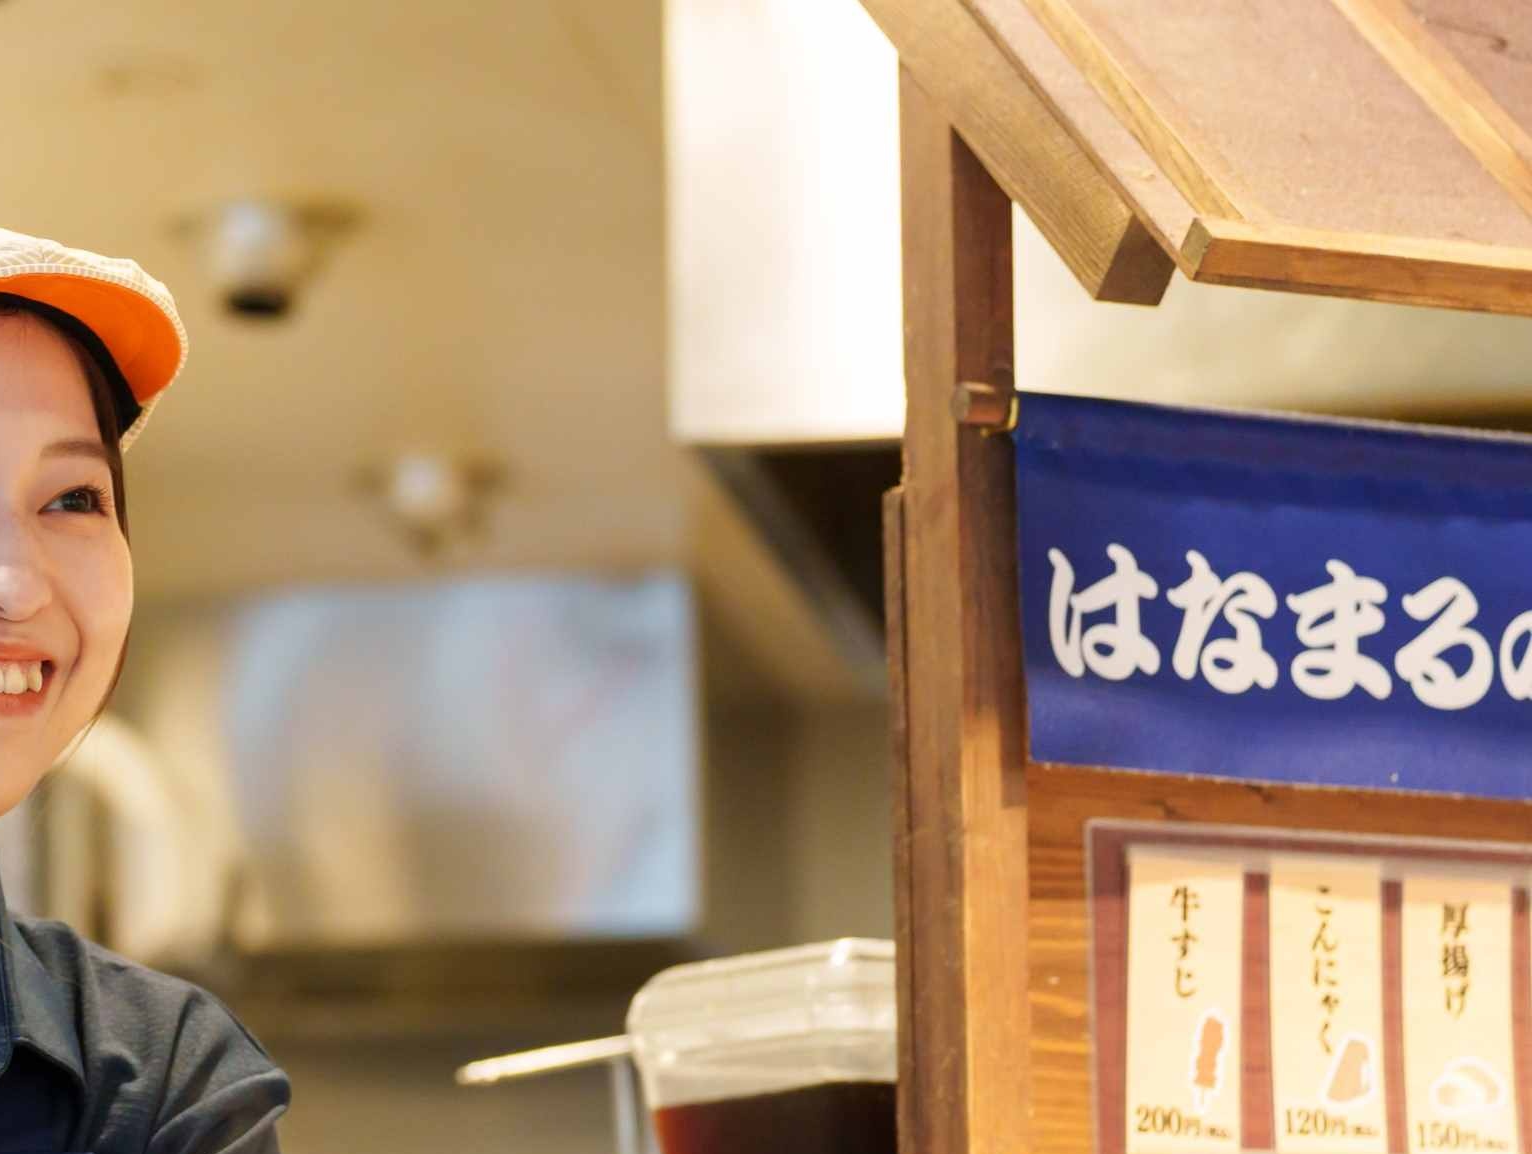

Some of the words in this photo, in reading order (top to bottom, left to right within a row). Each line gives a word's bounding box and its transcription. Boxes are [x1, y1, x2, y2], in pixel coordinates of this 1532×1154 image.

[1169, 884, 1202, 999] 牛すじ
[1310, 884, 1342, 1055] こんにゃく
[1440, 902, 1472, 1020] 厚揚げ
